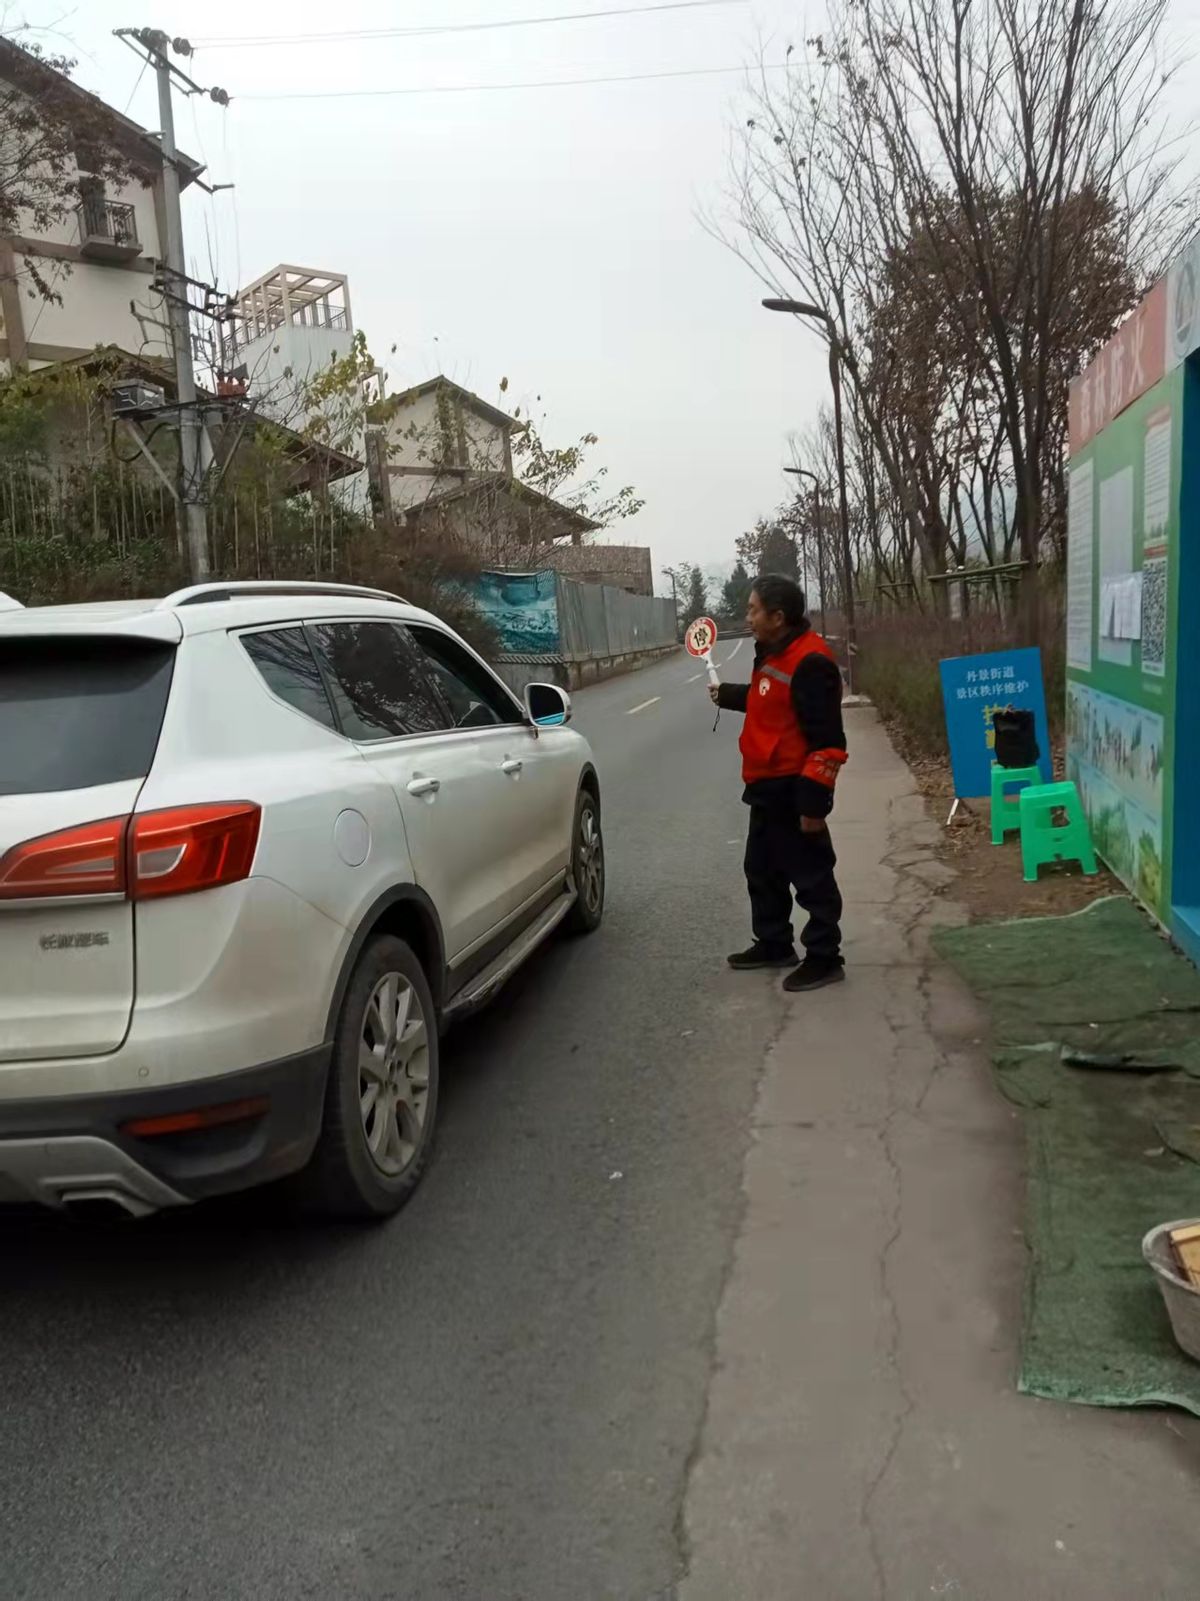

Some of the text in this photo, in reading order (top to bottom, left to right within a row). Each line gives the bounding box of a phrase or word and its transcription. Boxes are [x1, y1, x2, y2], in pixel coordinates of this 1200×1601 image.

[694, 627, 708, 647] 停
[956, 681, 1029, 699] 景区秩序维护
